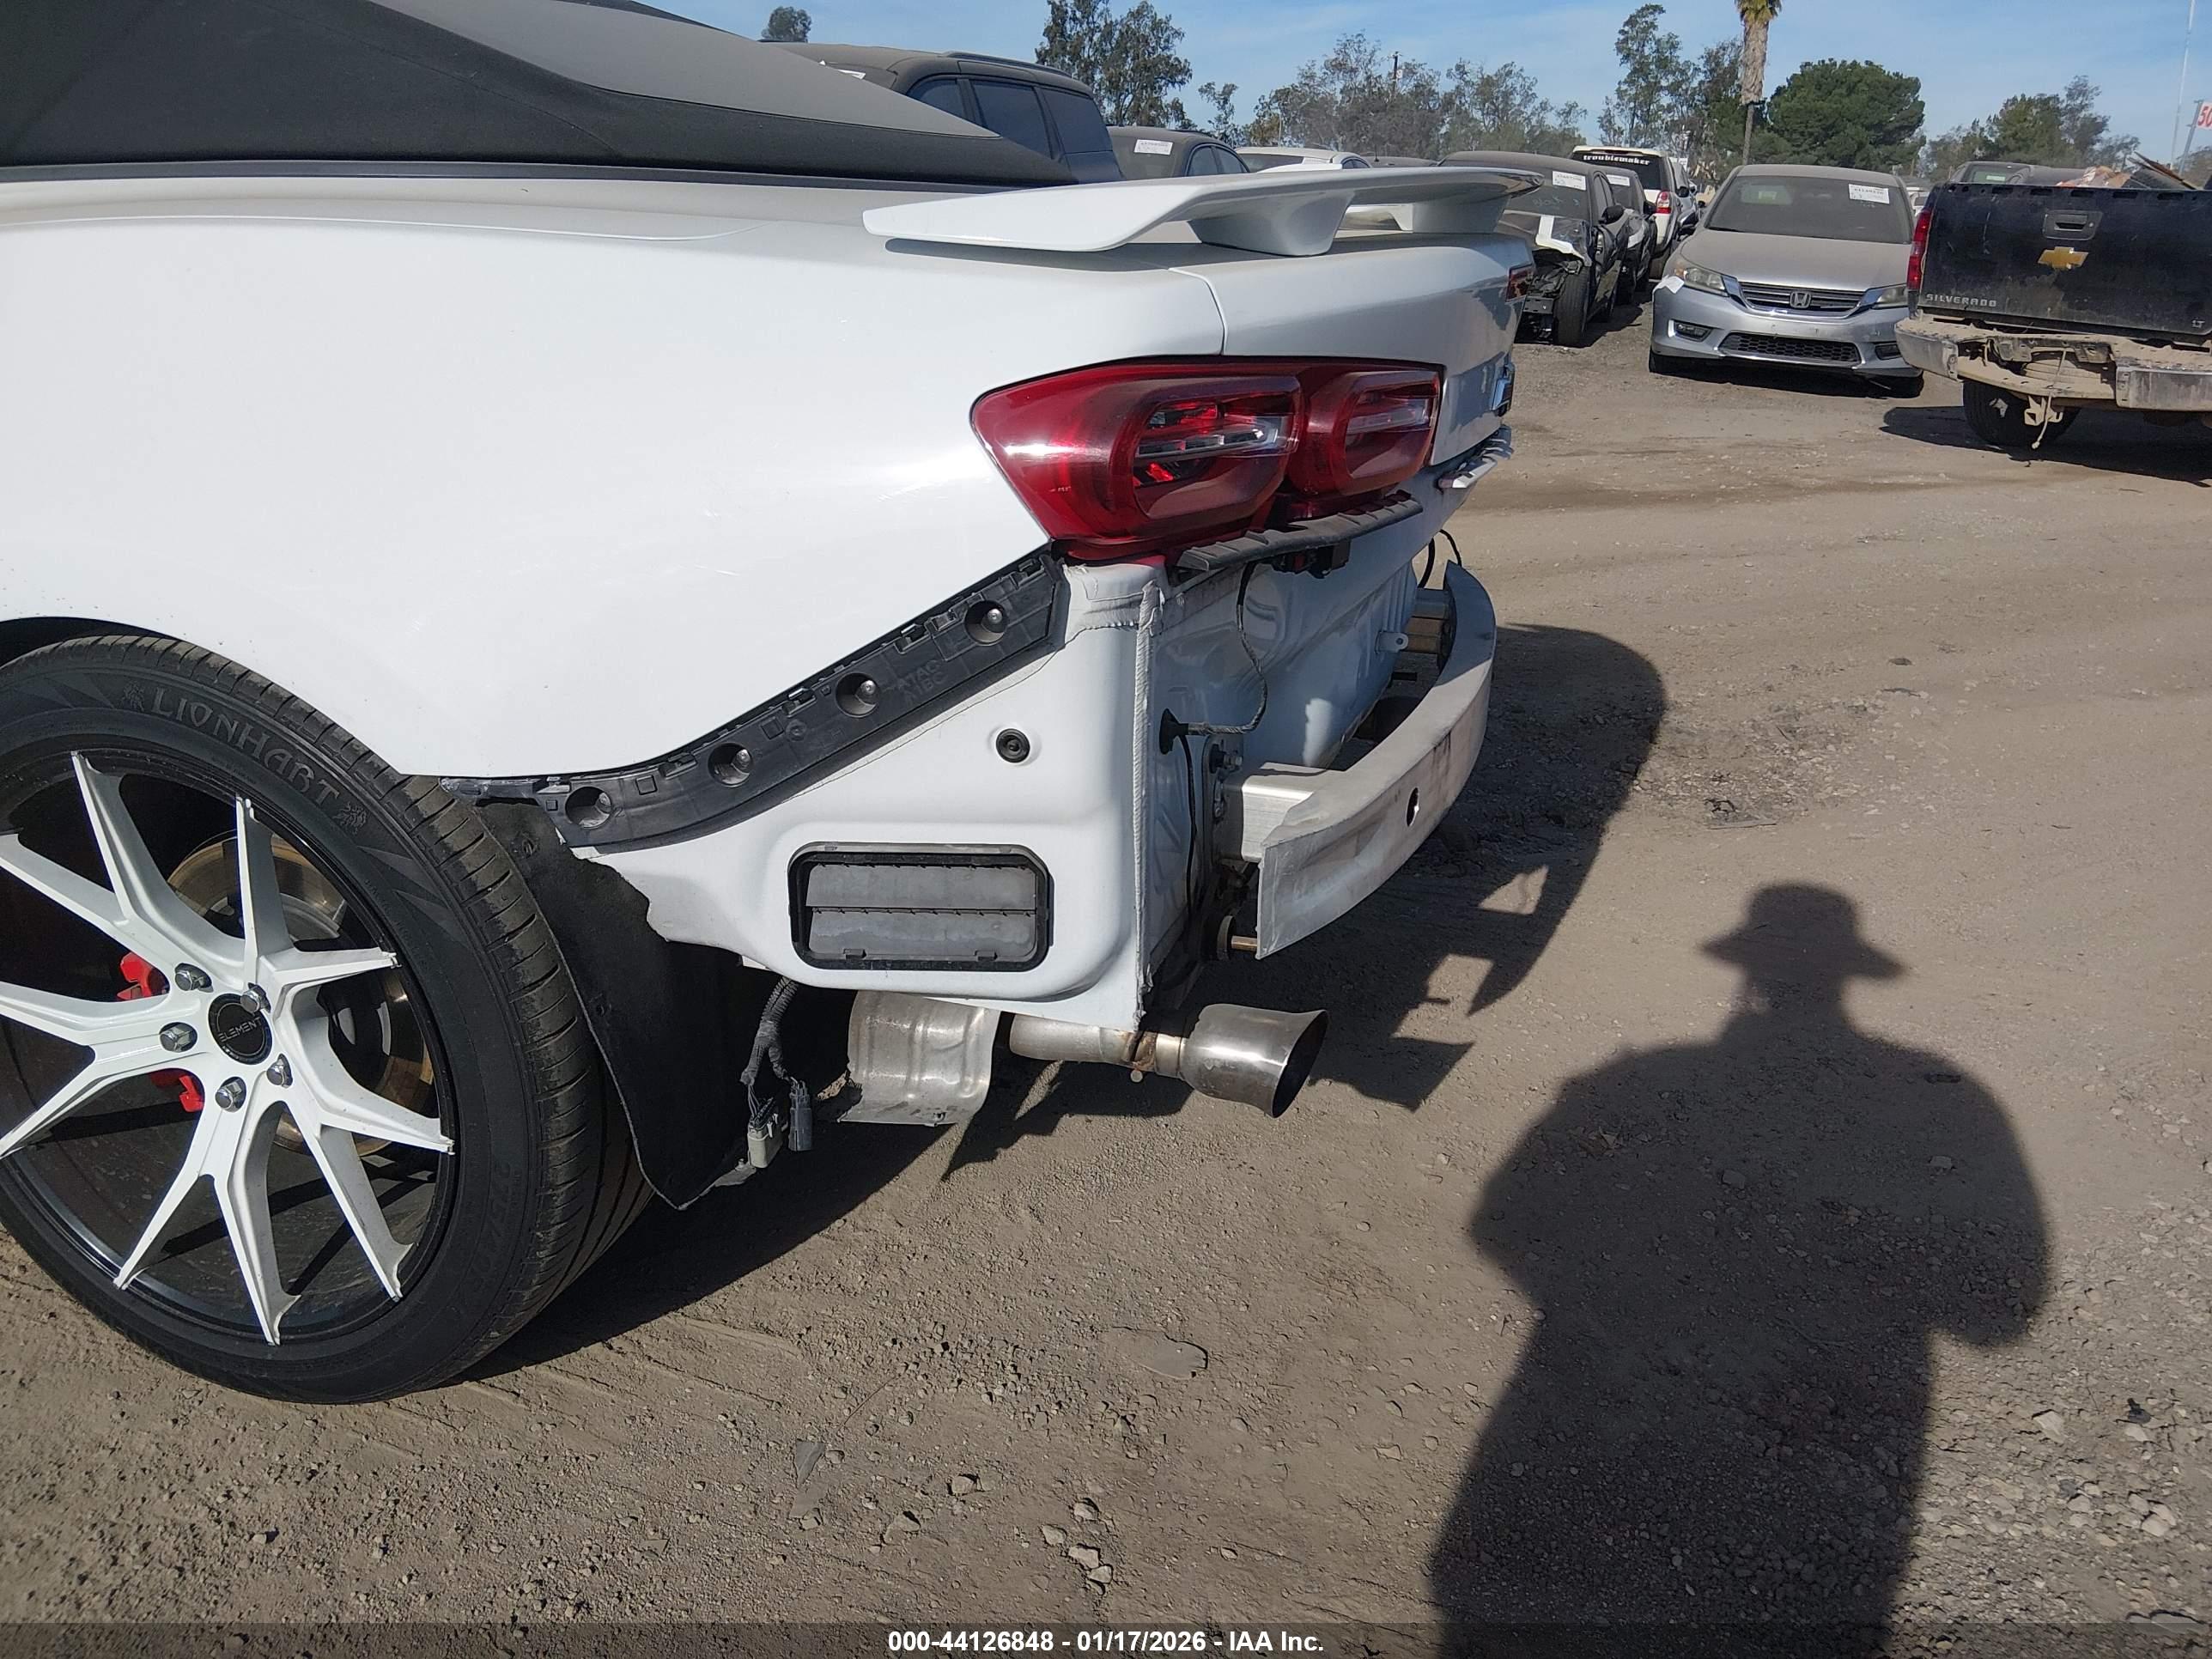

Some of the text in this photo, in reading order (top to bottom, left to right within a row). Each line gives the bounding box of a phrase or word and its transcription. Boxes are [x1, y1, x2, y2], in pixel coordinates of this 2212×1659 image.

[1583, 155, 1650, 165] troublemaker
[1925, 294, 1997, 307] SILVERADO
[2191, 319, 2206, 328] LT
[151, 689, 339, 809] LIONHART
[217, 1016, 262, 1042] ELEMENT
